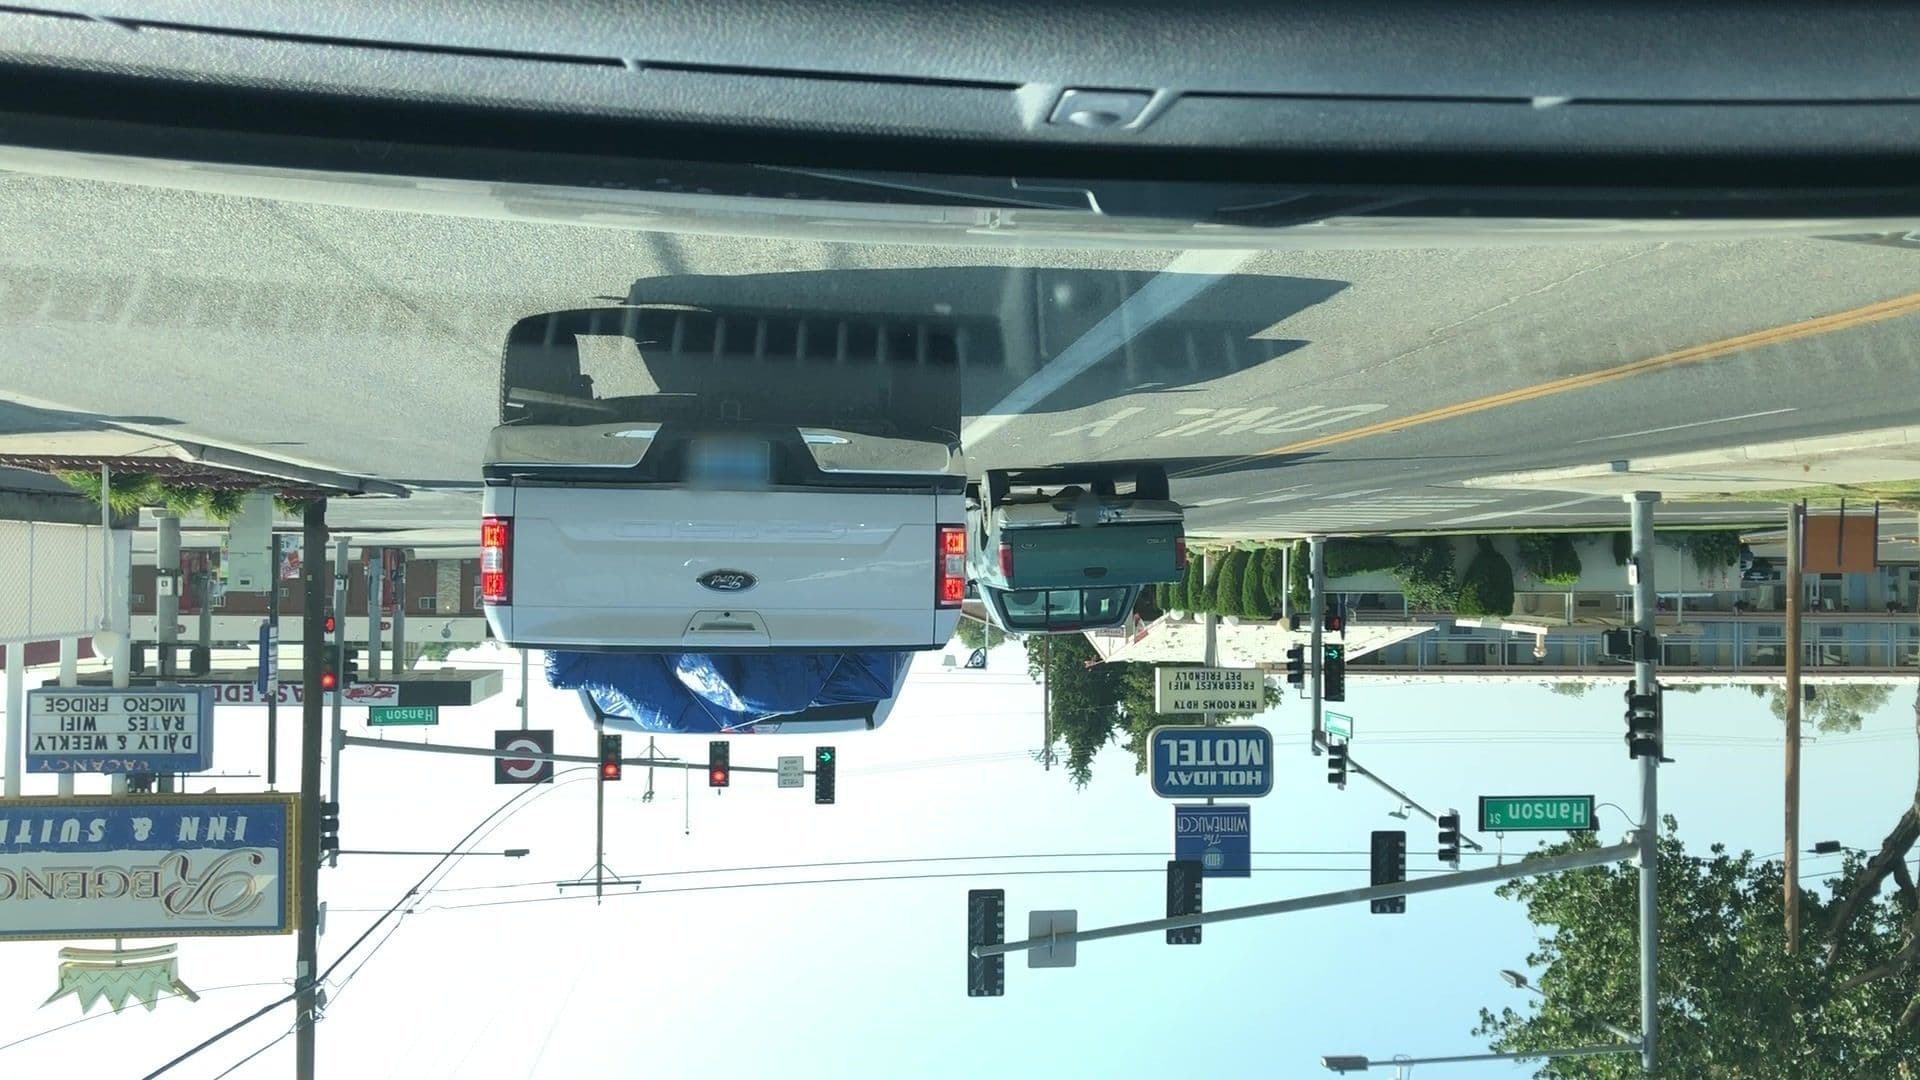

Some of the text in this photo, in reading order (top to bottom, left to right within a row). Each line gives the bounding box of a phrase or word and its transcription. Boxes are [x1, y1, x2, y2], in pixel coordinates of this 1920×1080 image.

[1175, 671, 1241, 681] PET FRIENDLY
[1168, 681, 1191, 690] WIFI
[45, 697, 185, 712] MICRO FRIDGE
[386, 709, 433, 722] Hanson
[60, 716, 185, 731] RATES WIFI
[34, 733, 192, 751] DAILY & WEEKLY
[1160, 739, 1264, 766] MOTEL
[40, 759, 149, 771] VACANCY
[1164, 771, 1262, 786] HOLIDAY
[1489, 802, 1585, 825] Hanson St
[130, 817, 153, 842] &
[177, 815, 248, 842] INN
[1177, 816, 1248, 833] WINNEMUCCA
[1203, 833, 1221, 847] The
